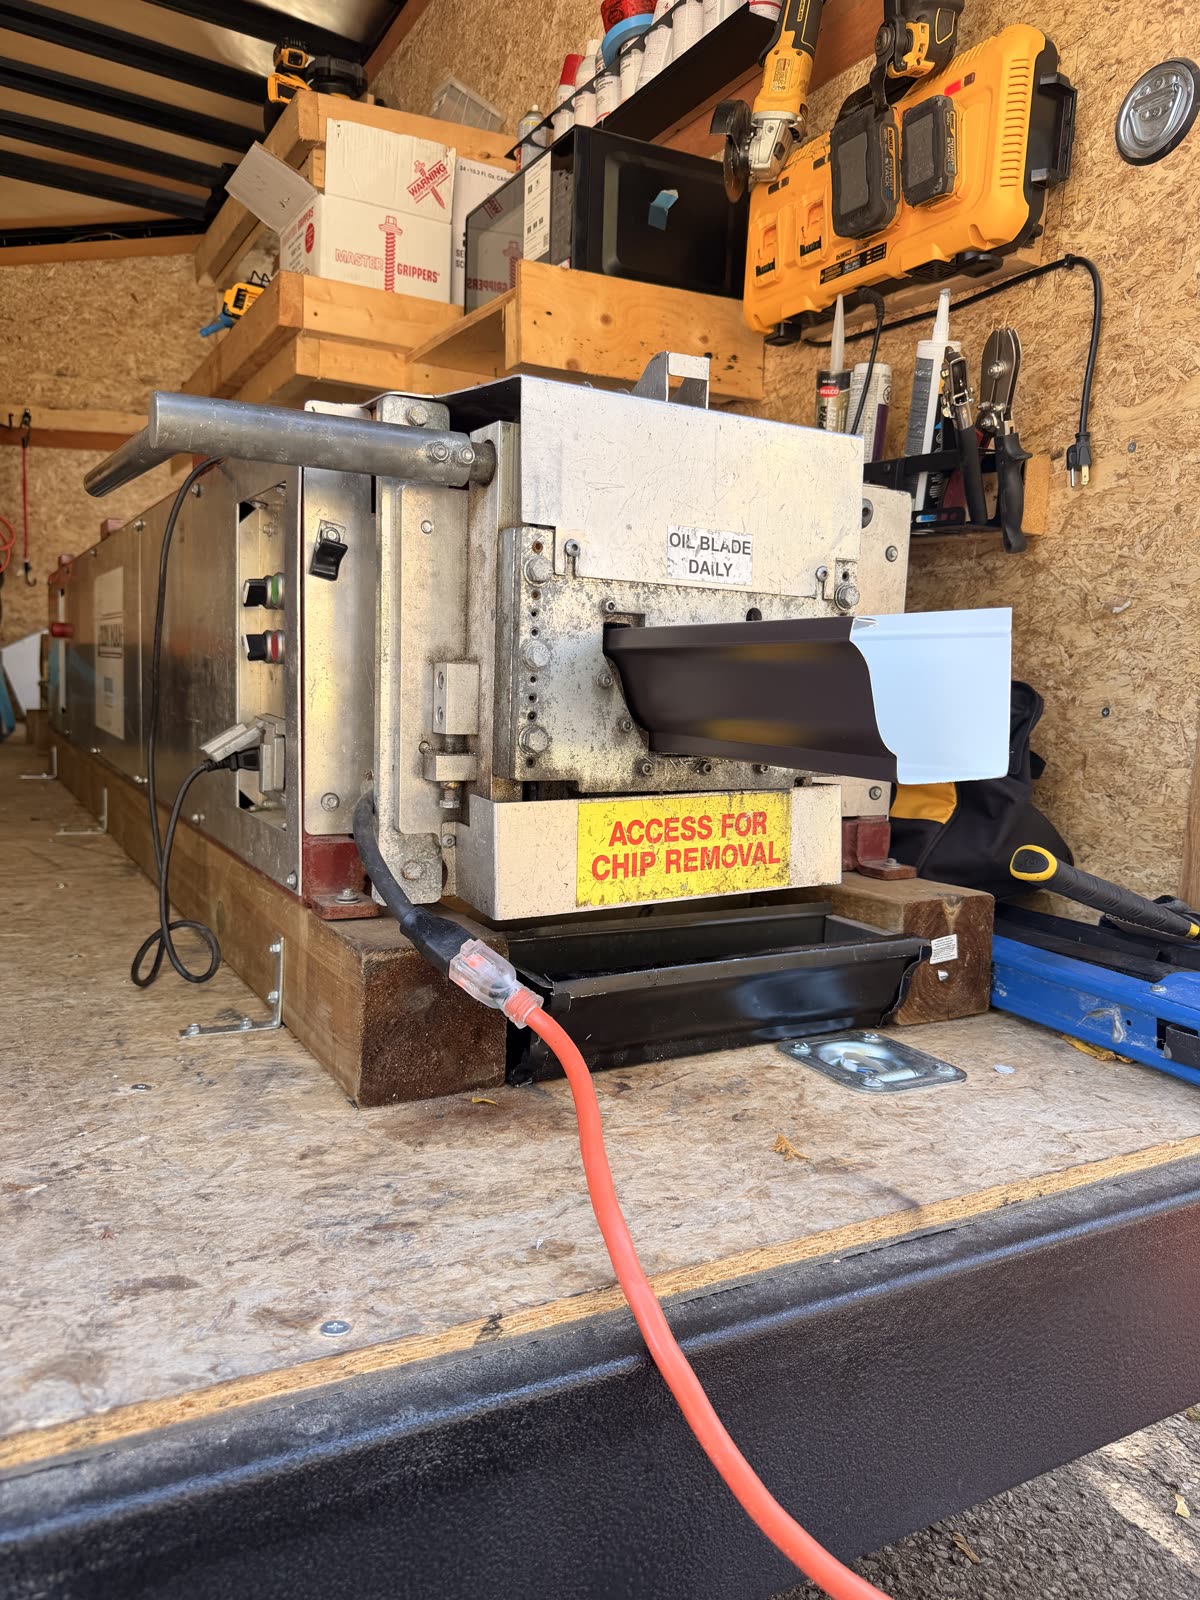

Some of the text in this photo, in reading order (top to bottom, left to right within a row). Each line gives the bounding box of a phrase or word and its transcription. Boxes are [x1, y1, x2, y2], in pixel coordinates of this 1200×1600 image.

[408, 163, 447, 197] WARNING
[335, 248, 439, 283] MASTER GRIPPERS
[669, 532, 752, 556] OIL BLADE
[688, 559, 733, 577] DAILY
[608, 811, 768, 847] ACCESS FOR
[591, 841, 781, 881] CHIP REMOVAL
